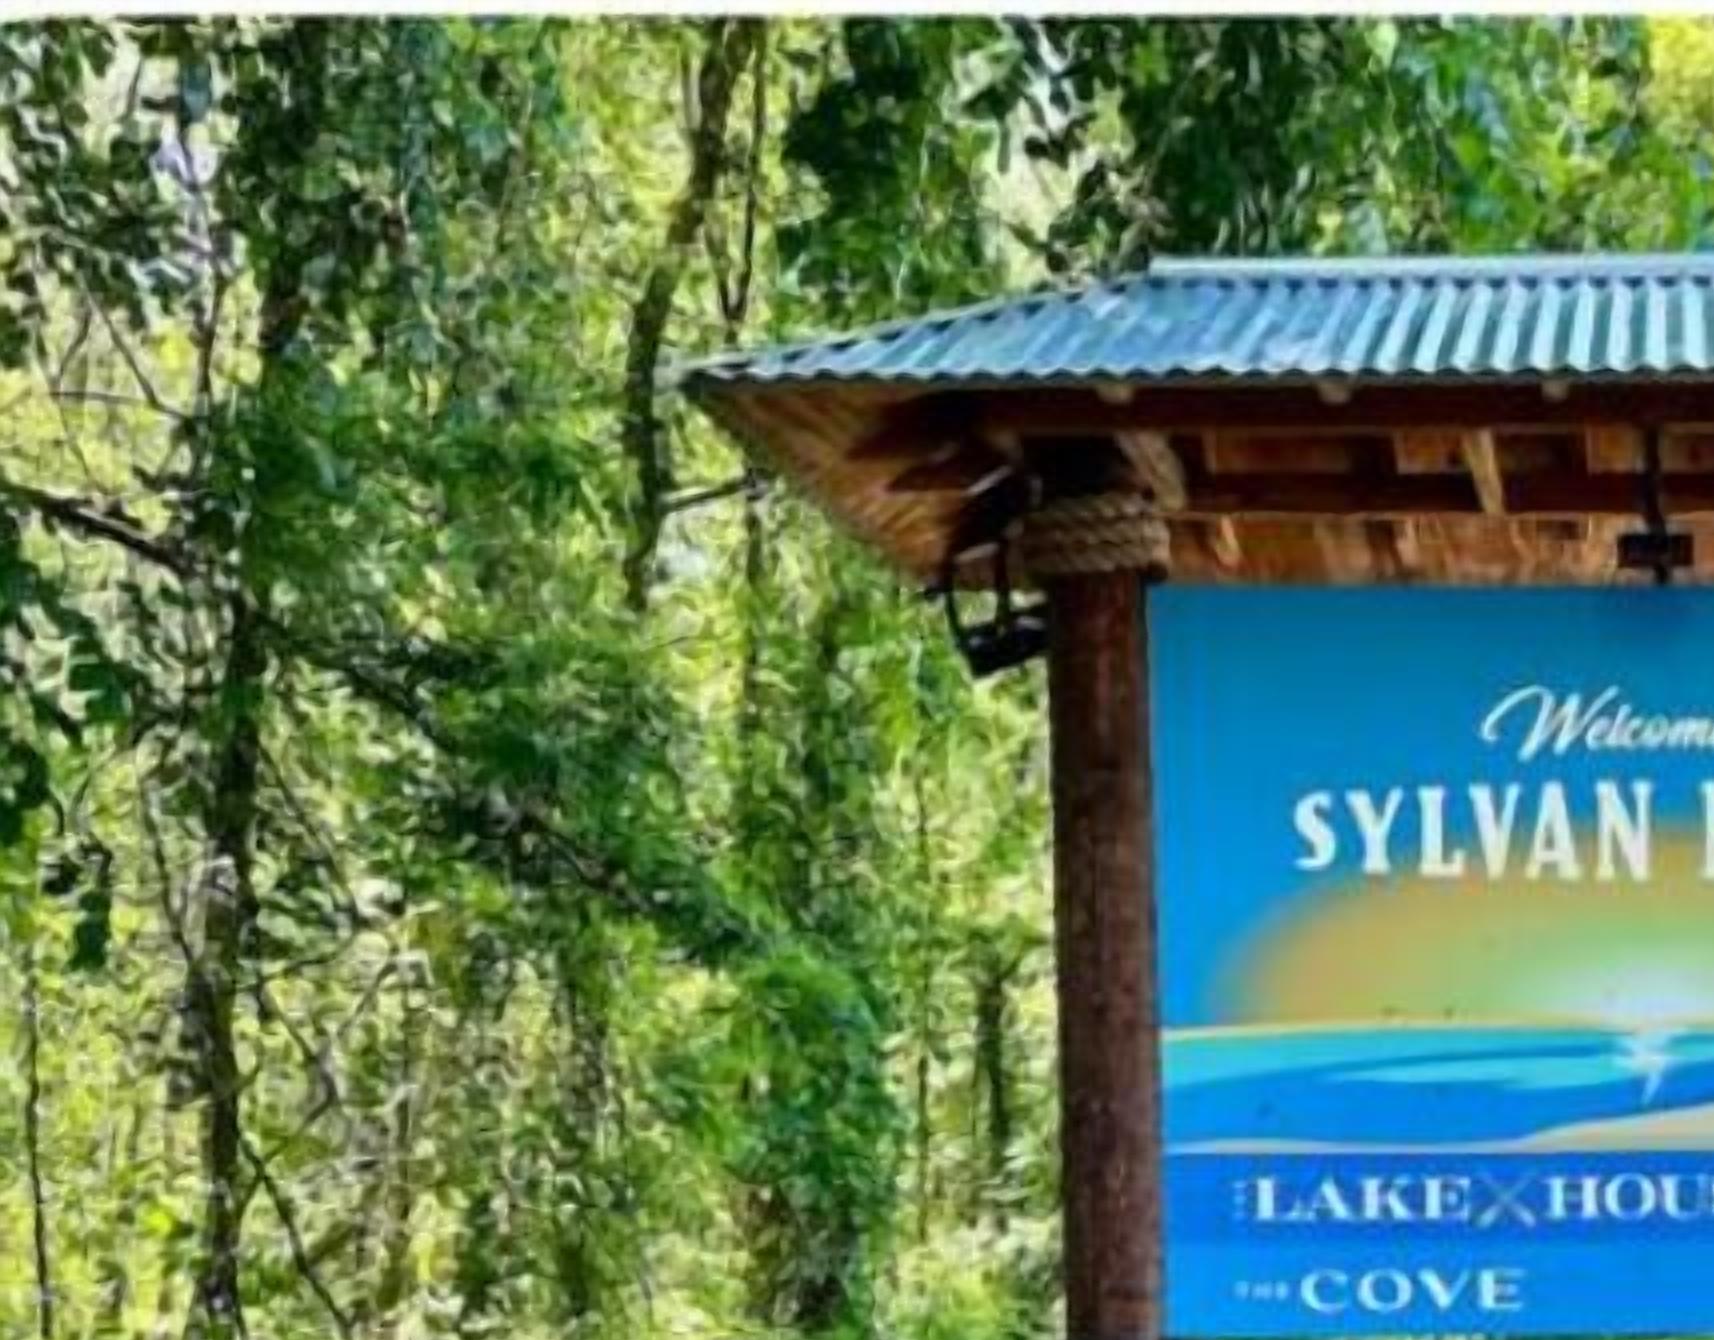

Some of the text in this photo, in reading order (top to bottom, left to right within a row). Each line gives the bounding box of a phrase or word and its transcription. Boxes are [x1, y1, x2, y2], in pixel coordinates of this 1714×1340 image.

[1294, 779, 1654, 880] SYLVAN
[1254, 1175, 1472, 1221] LAKE
[1300, 1268, 1524, 1312] COVE
